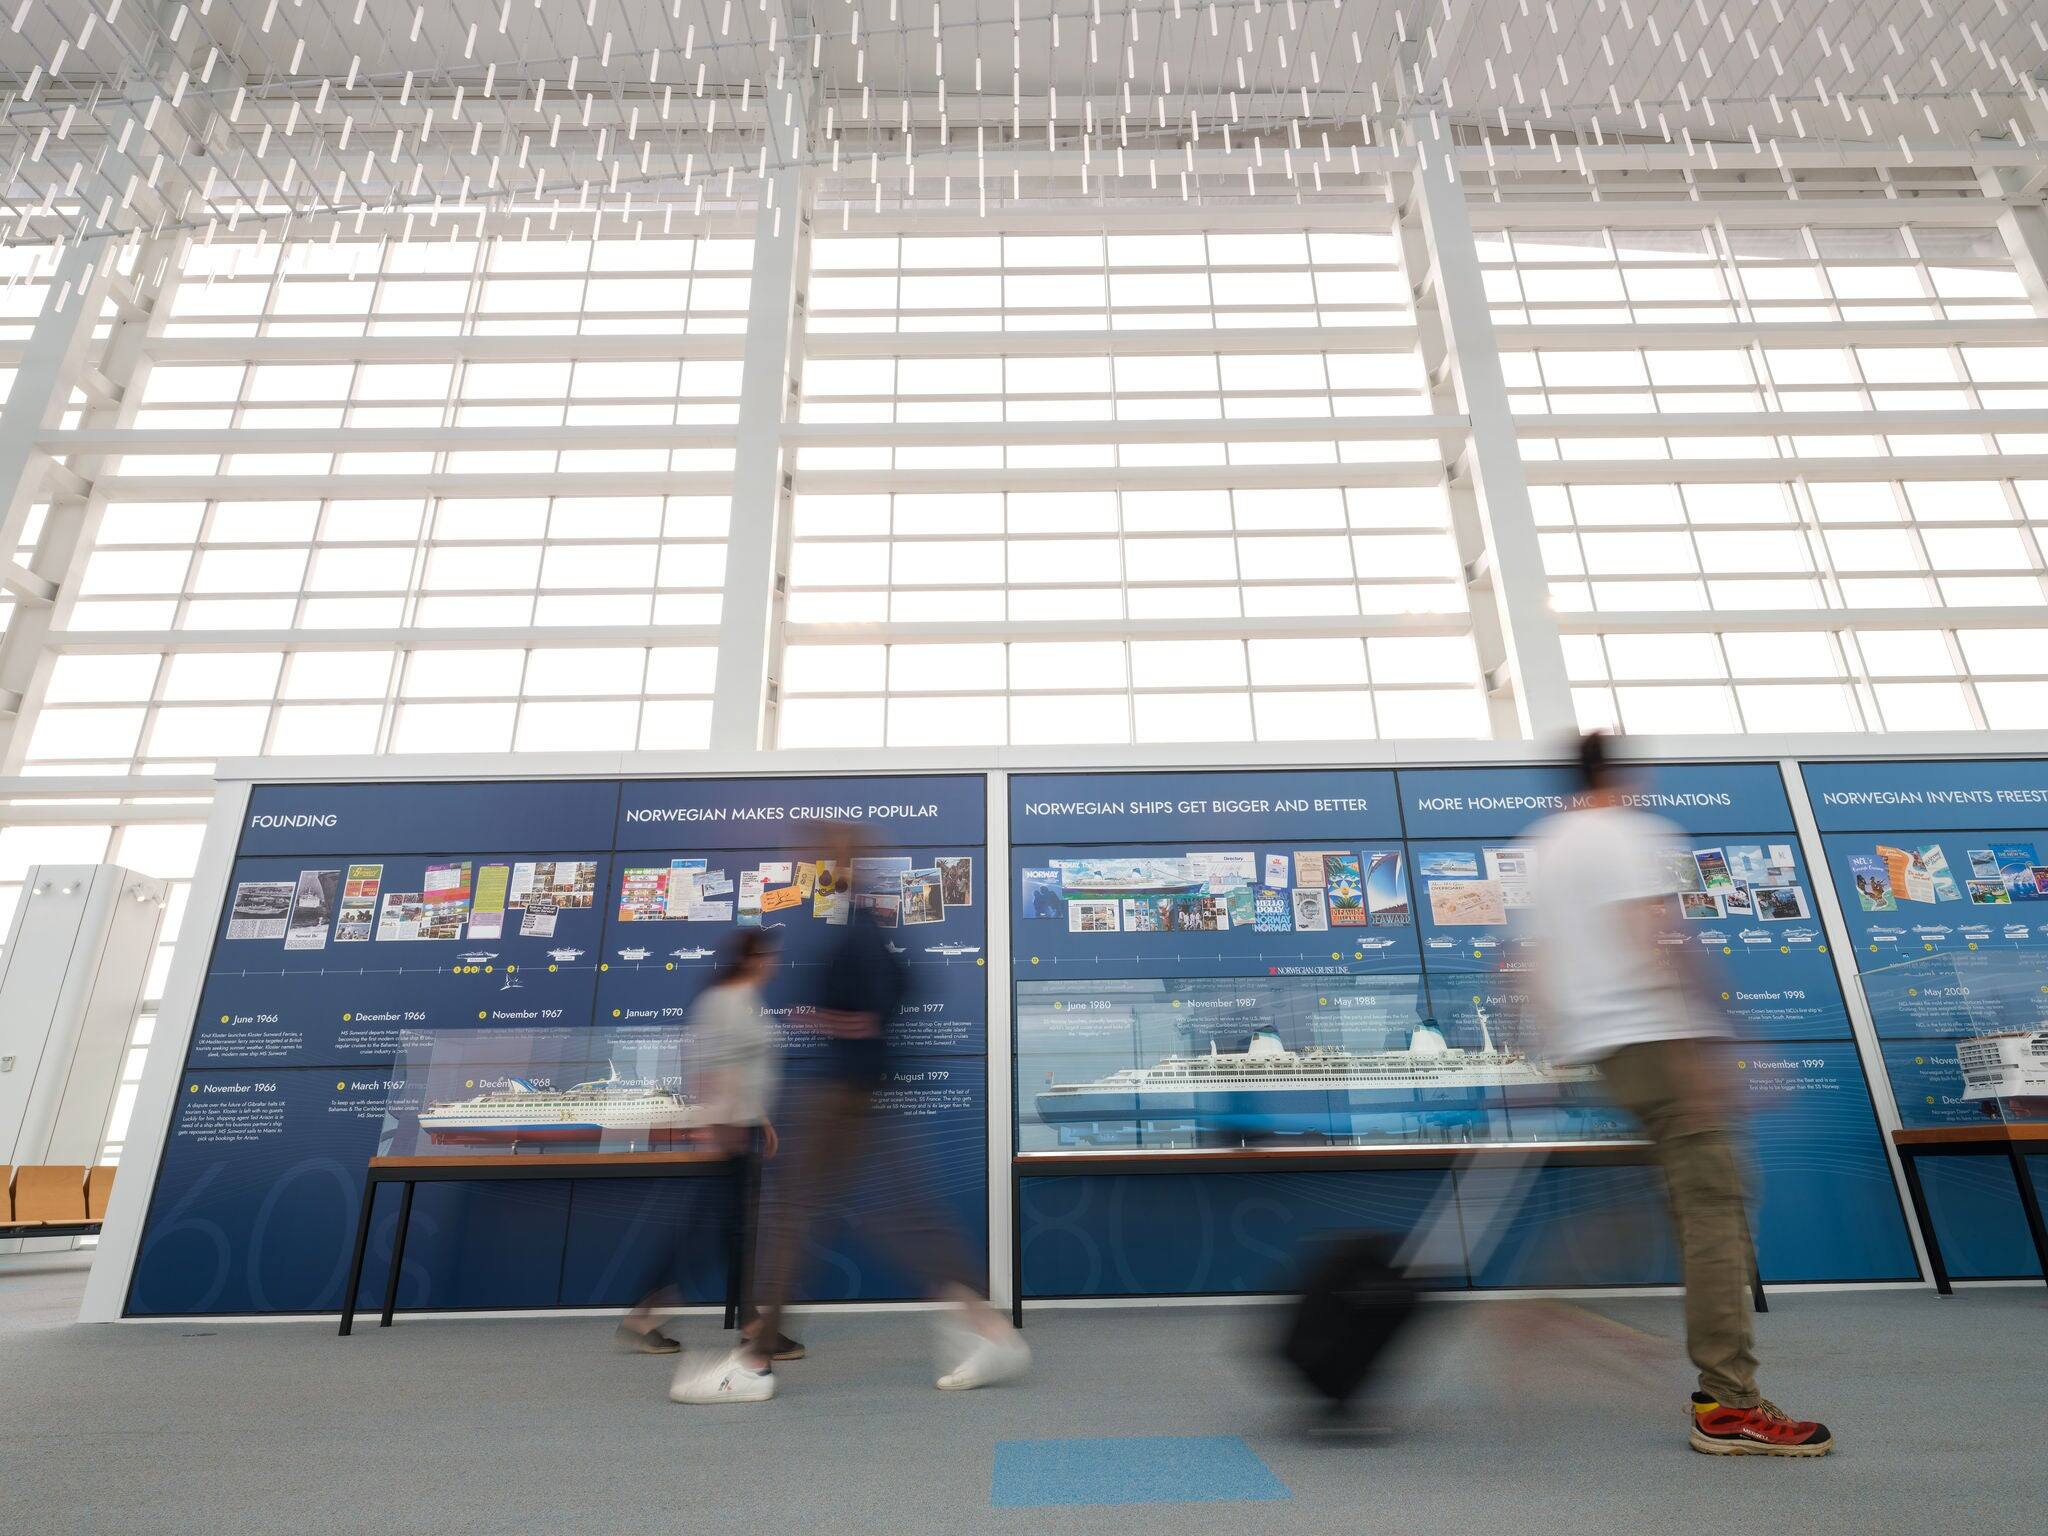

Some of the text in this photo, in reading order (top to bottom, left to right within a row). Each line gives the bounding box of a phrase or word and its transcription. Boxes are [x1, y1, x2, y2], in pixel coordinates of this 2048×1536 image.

[1418, 793, 1731, 811] MORE HOMEPORTS, MOE DESTINATIONS
[1823, 792, 1923, 805] NORWEGIAN
[1926, 790, 1991, 803] INVENTS
[1025, 798, 1367, 815] NORWEGIAN SHIPS GET BIGGER AND BETTER
[627, 804, 938, 822] NORWEGIAN MAKES CRUISING POPULAR
[252, 815, 337, 828] FOUNDING
[1026, 871, 1058, 879] NORWAY
[1254, 924, 1291, 932] NORWAY
[1277, 966, 1314, 974] NORWEGIAN
[1314, 966, 1335, 974] CRUISE
[1736, 990, 1806, 1000] December 1998
[1924, 987, 1970, 998] May 2000
[1188, 998, 1256, 1008] November 1987
[1334, 996, 1376, 1006] May 1988
[1486, 994, 1506, 1006] April
[760, 1006, 816, 1016] January 1974
[900, 1004, 944, 1014] June 1977
[1067, 1000, 1111, 1012] June 1980
[356, 1011, 426, 1021] December 1966
[492, 1009, 562, 1018] November 1967
[624, 1008, 683, 1019] January 1970
[232, 1014, 278, 1026] June 1966
[1752, 1059, 1824, 1069] November 1999
[662, 1076, 682, 1086] 1971
[893, 1072, 950, 1083] August 1979
[204, 1082, 276, 1093] November 1966
[350, 1080, 406, 1090] March 1967
[480, 1078, 550, 1088] Decem 1968
